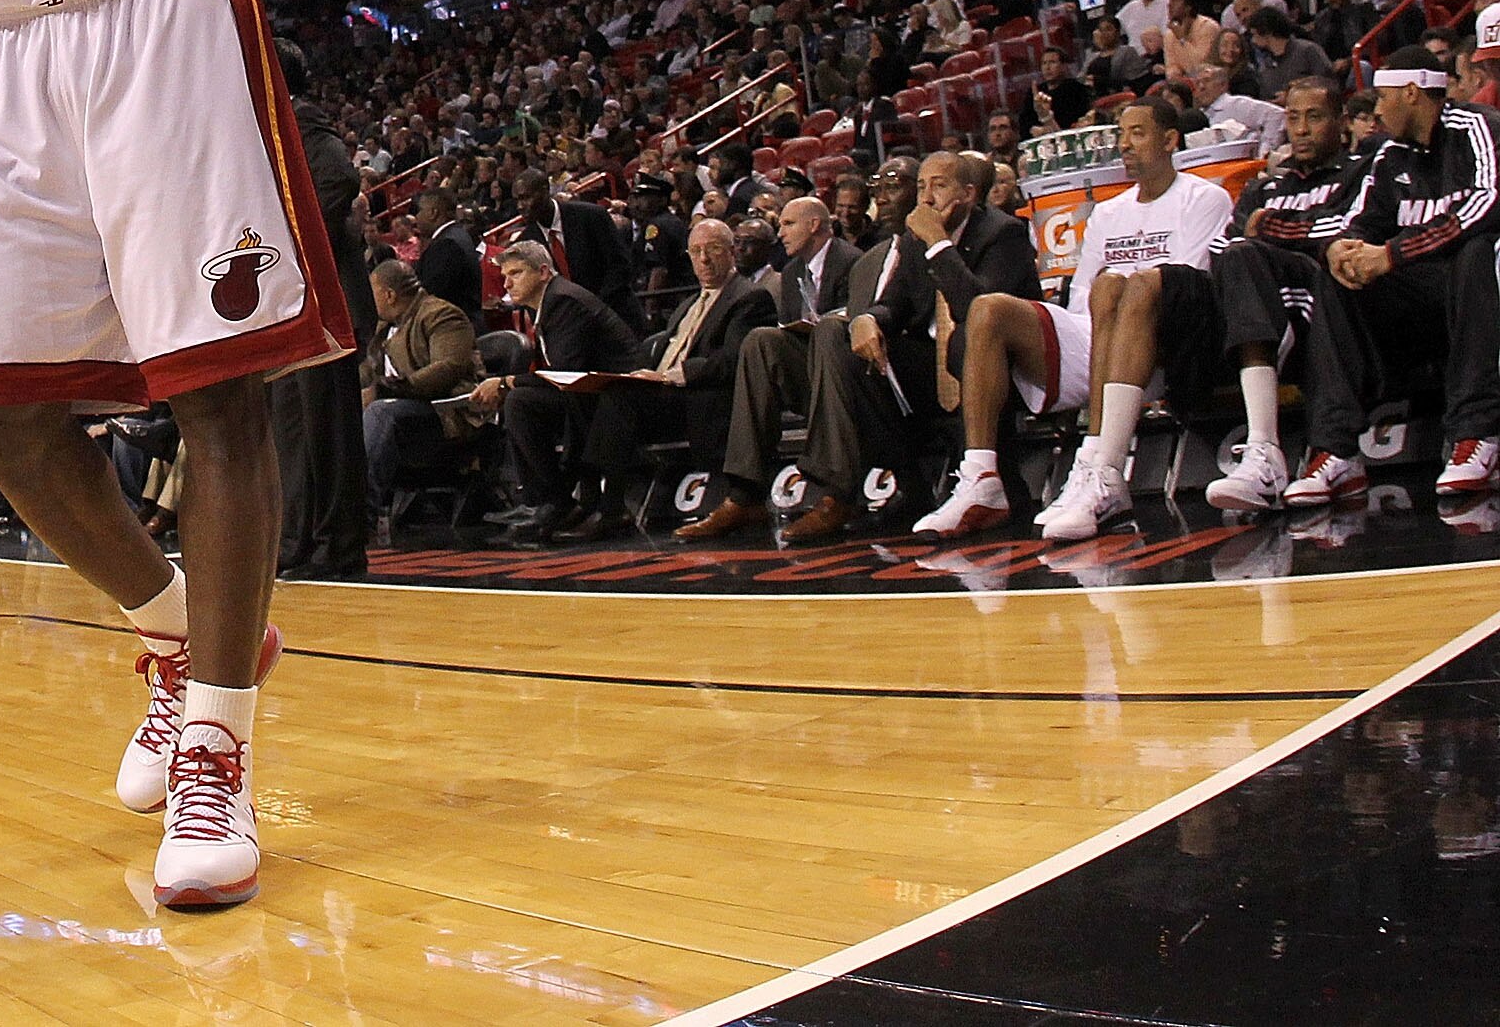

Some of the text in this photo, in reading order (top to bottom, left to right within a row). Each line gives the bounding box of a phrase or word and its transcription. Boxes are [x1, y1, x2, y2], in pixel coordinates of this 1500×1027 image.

[1396, 188, 1472, 227] MIA
[1043, 212, 1077, 256] G
[1104, 245, 1170, 262] BASKETBALL
[1105, 233, 1172, 251] MIAMI HEAT
[674, 472, 710, 512] G
[771, 464, 806, 508] G
